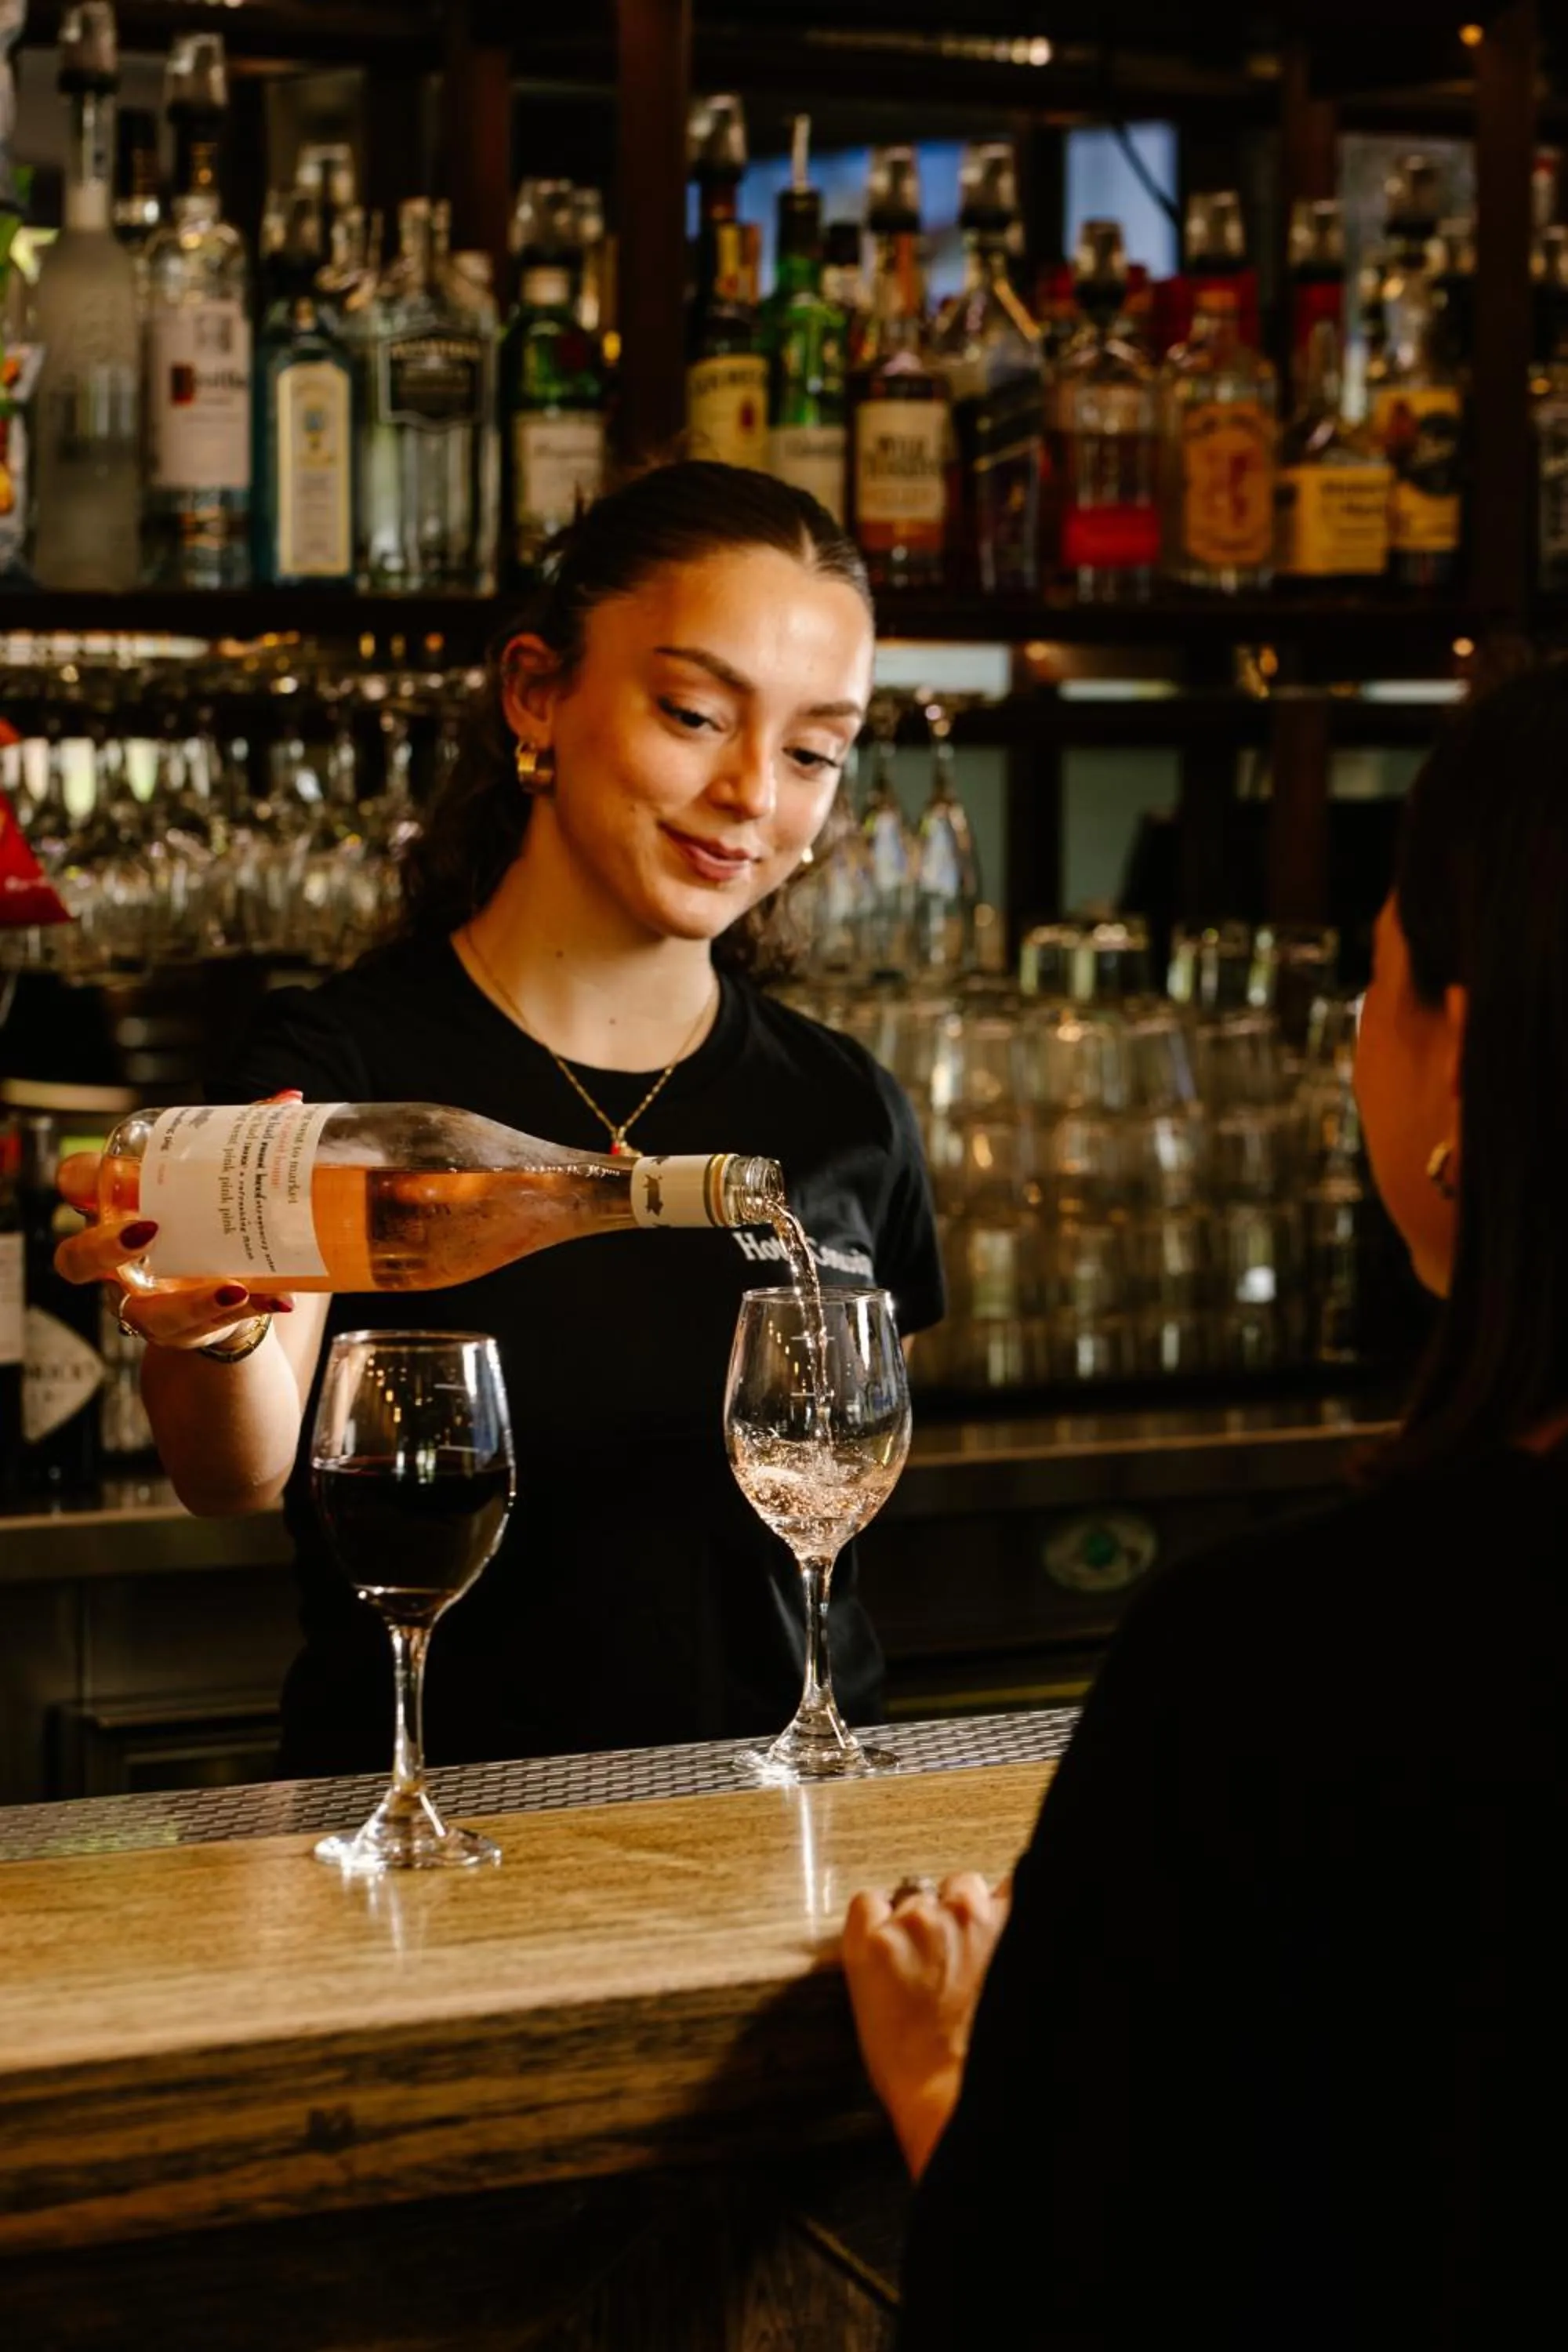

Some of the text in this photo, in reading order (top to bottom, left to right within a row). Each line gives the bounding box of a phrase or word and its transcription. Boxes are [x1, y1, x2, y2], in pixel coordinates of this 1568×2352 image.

[263, 1122, 282, 1139] had
[220, 1148, 236, 1172] pink
[290, 1146, 303, 1158] to
[218, 1177, 234, 1203] pink
[287, 1161, 301, 1204] market
[217, 1208, 237, 1234] pink
